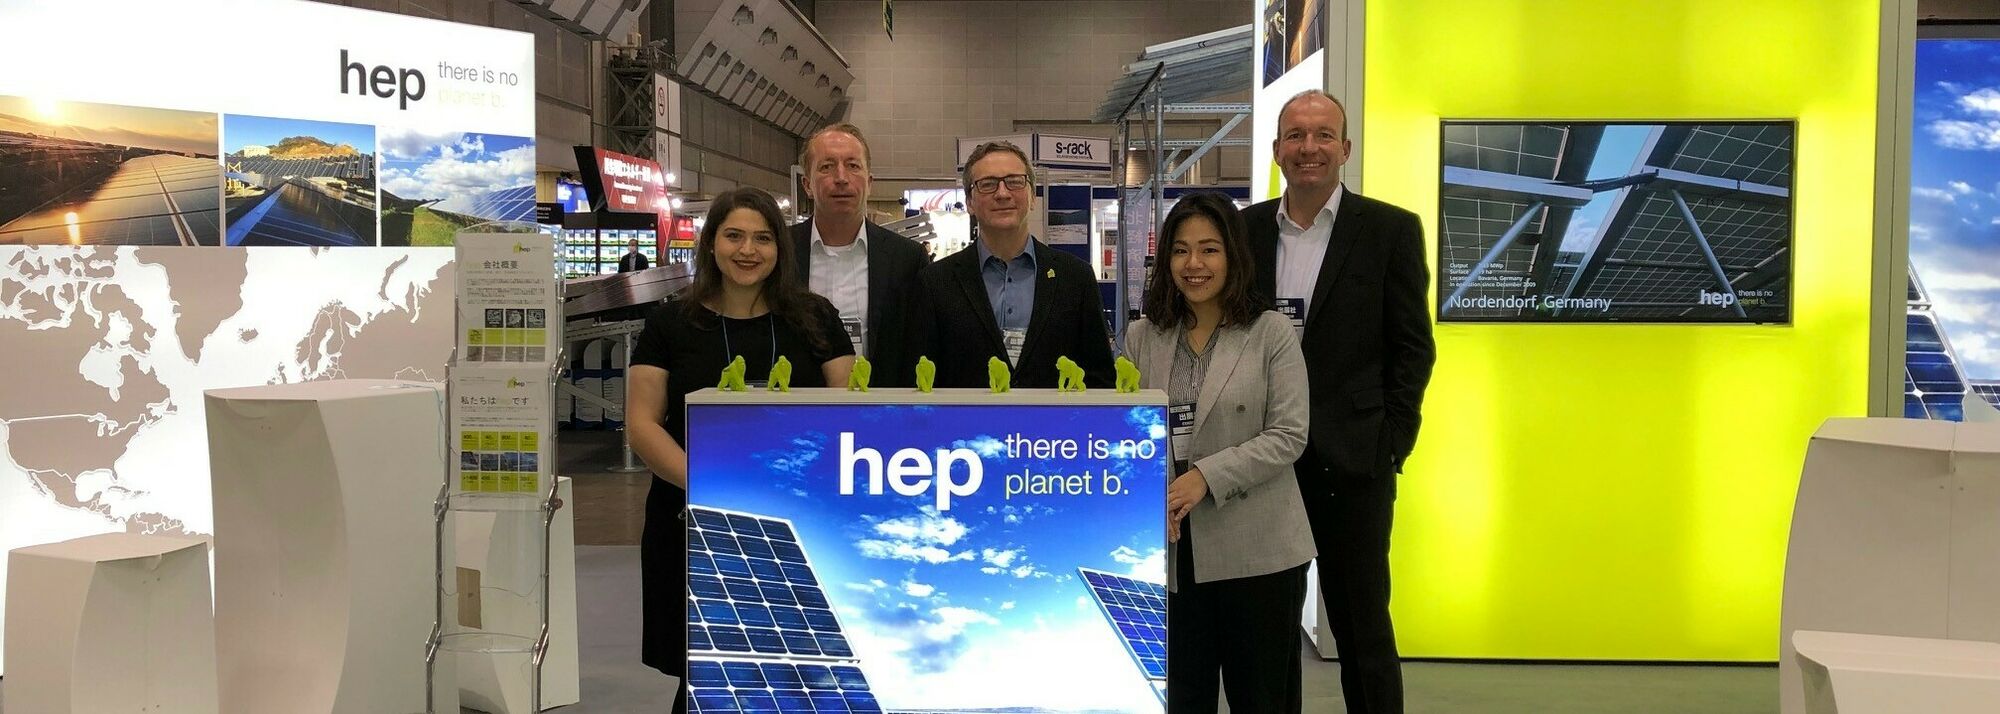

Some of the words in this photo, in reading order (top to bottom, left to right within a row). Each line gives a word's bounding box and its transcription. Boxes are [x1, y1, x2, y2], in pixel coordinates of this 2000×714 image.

[340, 49, 426, 111] hep
[438, 61, 478, 82] there
[482, 66, 495, 84] is
[499, 72, 518, 86] no
[1056, 141, 1093, 160] s-rack
[483, 260, 519, 269] 会社概要
[1450, 295, 1540, 310] Nordendorf,
[1544, 296, 1612, 312] Germany
[1700, 289, 1734, 308] hep
[1738, 289, 1756, 297] there
[1756, 289, 1763, 297] is
[1005, 433, 1078, 460] there
[1088, 433, 1109, 460] is
[1119, 438, 1155, 460] no
[840, 432, 984, 511] hep
[1005, 469, 1092, 499] planet
[1102, 469, 1129, 495] b.
